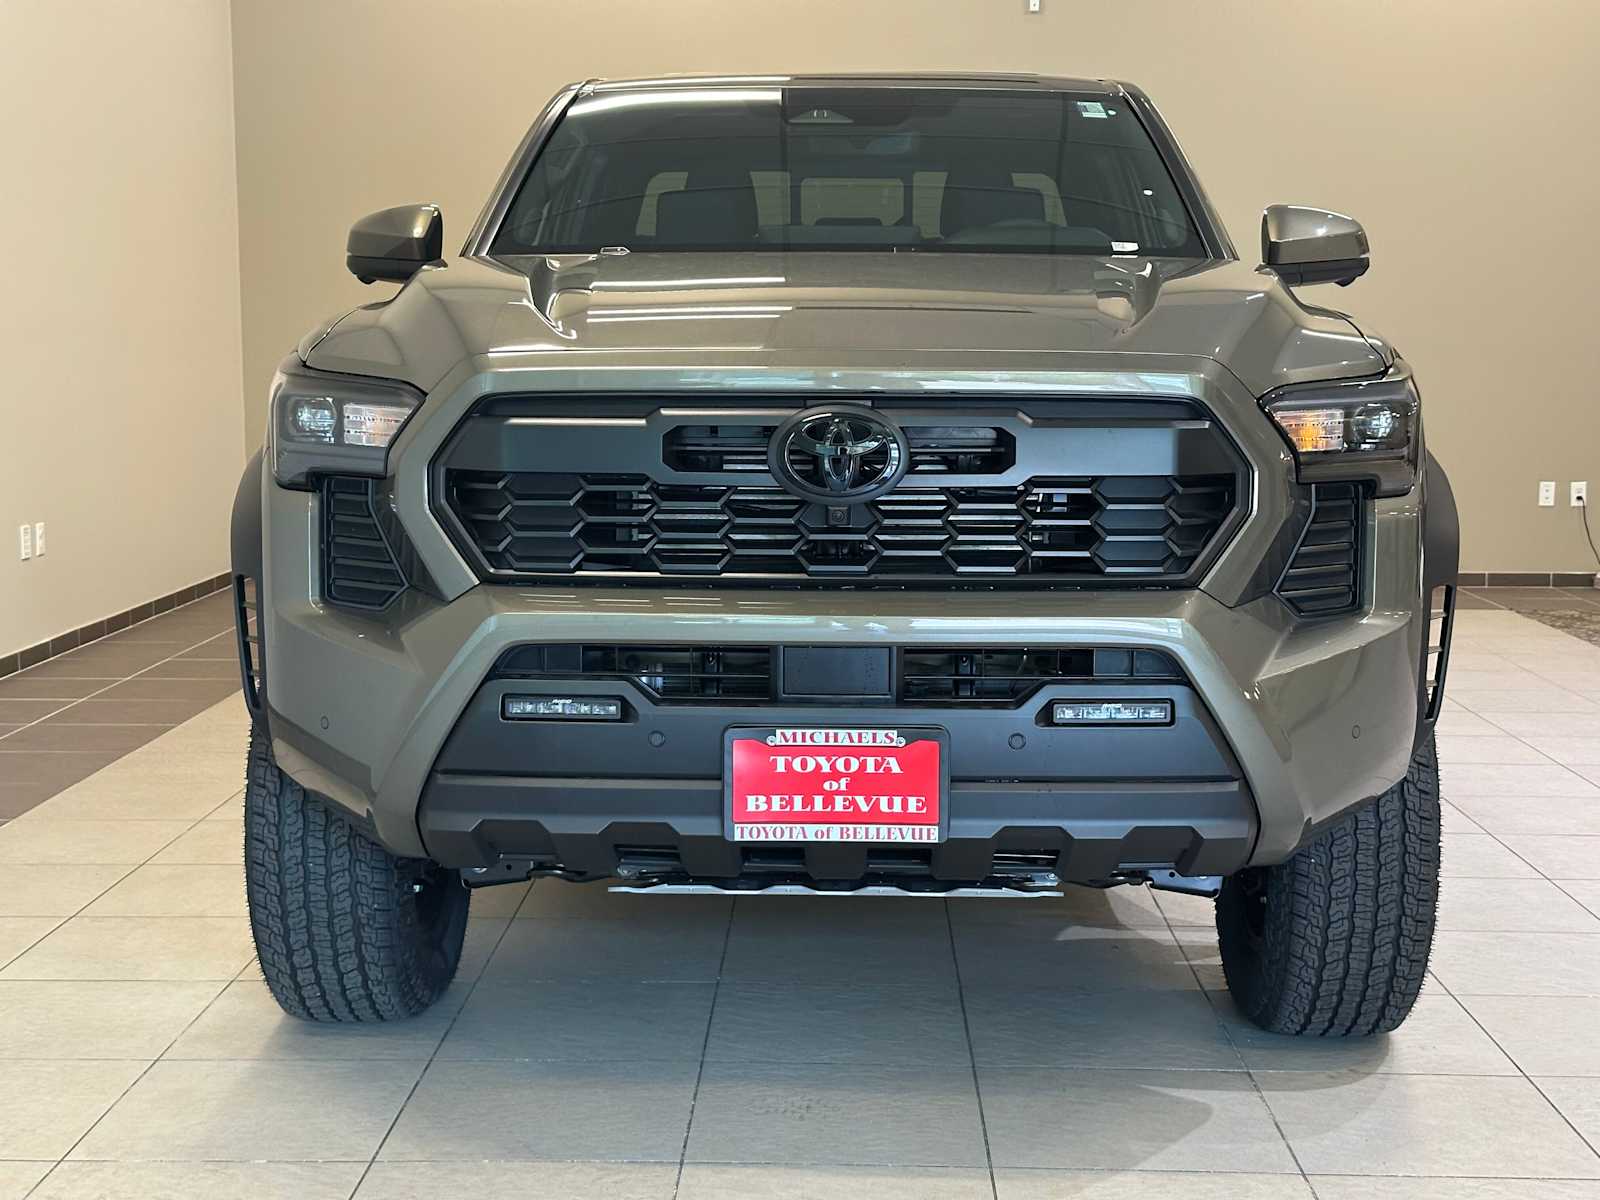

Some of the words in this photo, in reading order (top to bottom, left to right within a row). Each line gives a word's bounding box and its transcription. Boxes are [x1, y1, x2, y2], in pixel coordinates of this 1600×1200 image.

[779, 731, 896, 744] MICHAELS
[769, 756, 904, 774] TOYOTA
[822, 777, 851, 792] of
[745, 795, 928, 814] BELLEVUE
[736, 826, 807, 840] TOYOTA
[814, 826, 834, 840] of
[839, 826, 938, 841] BELLEVUE
